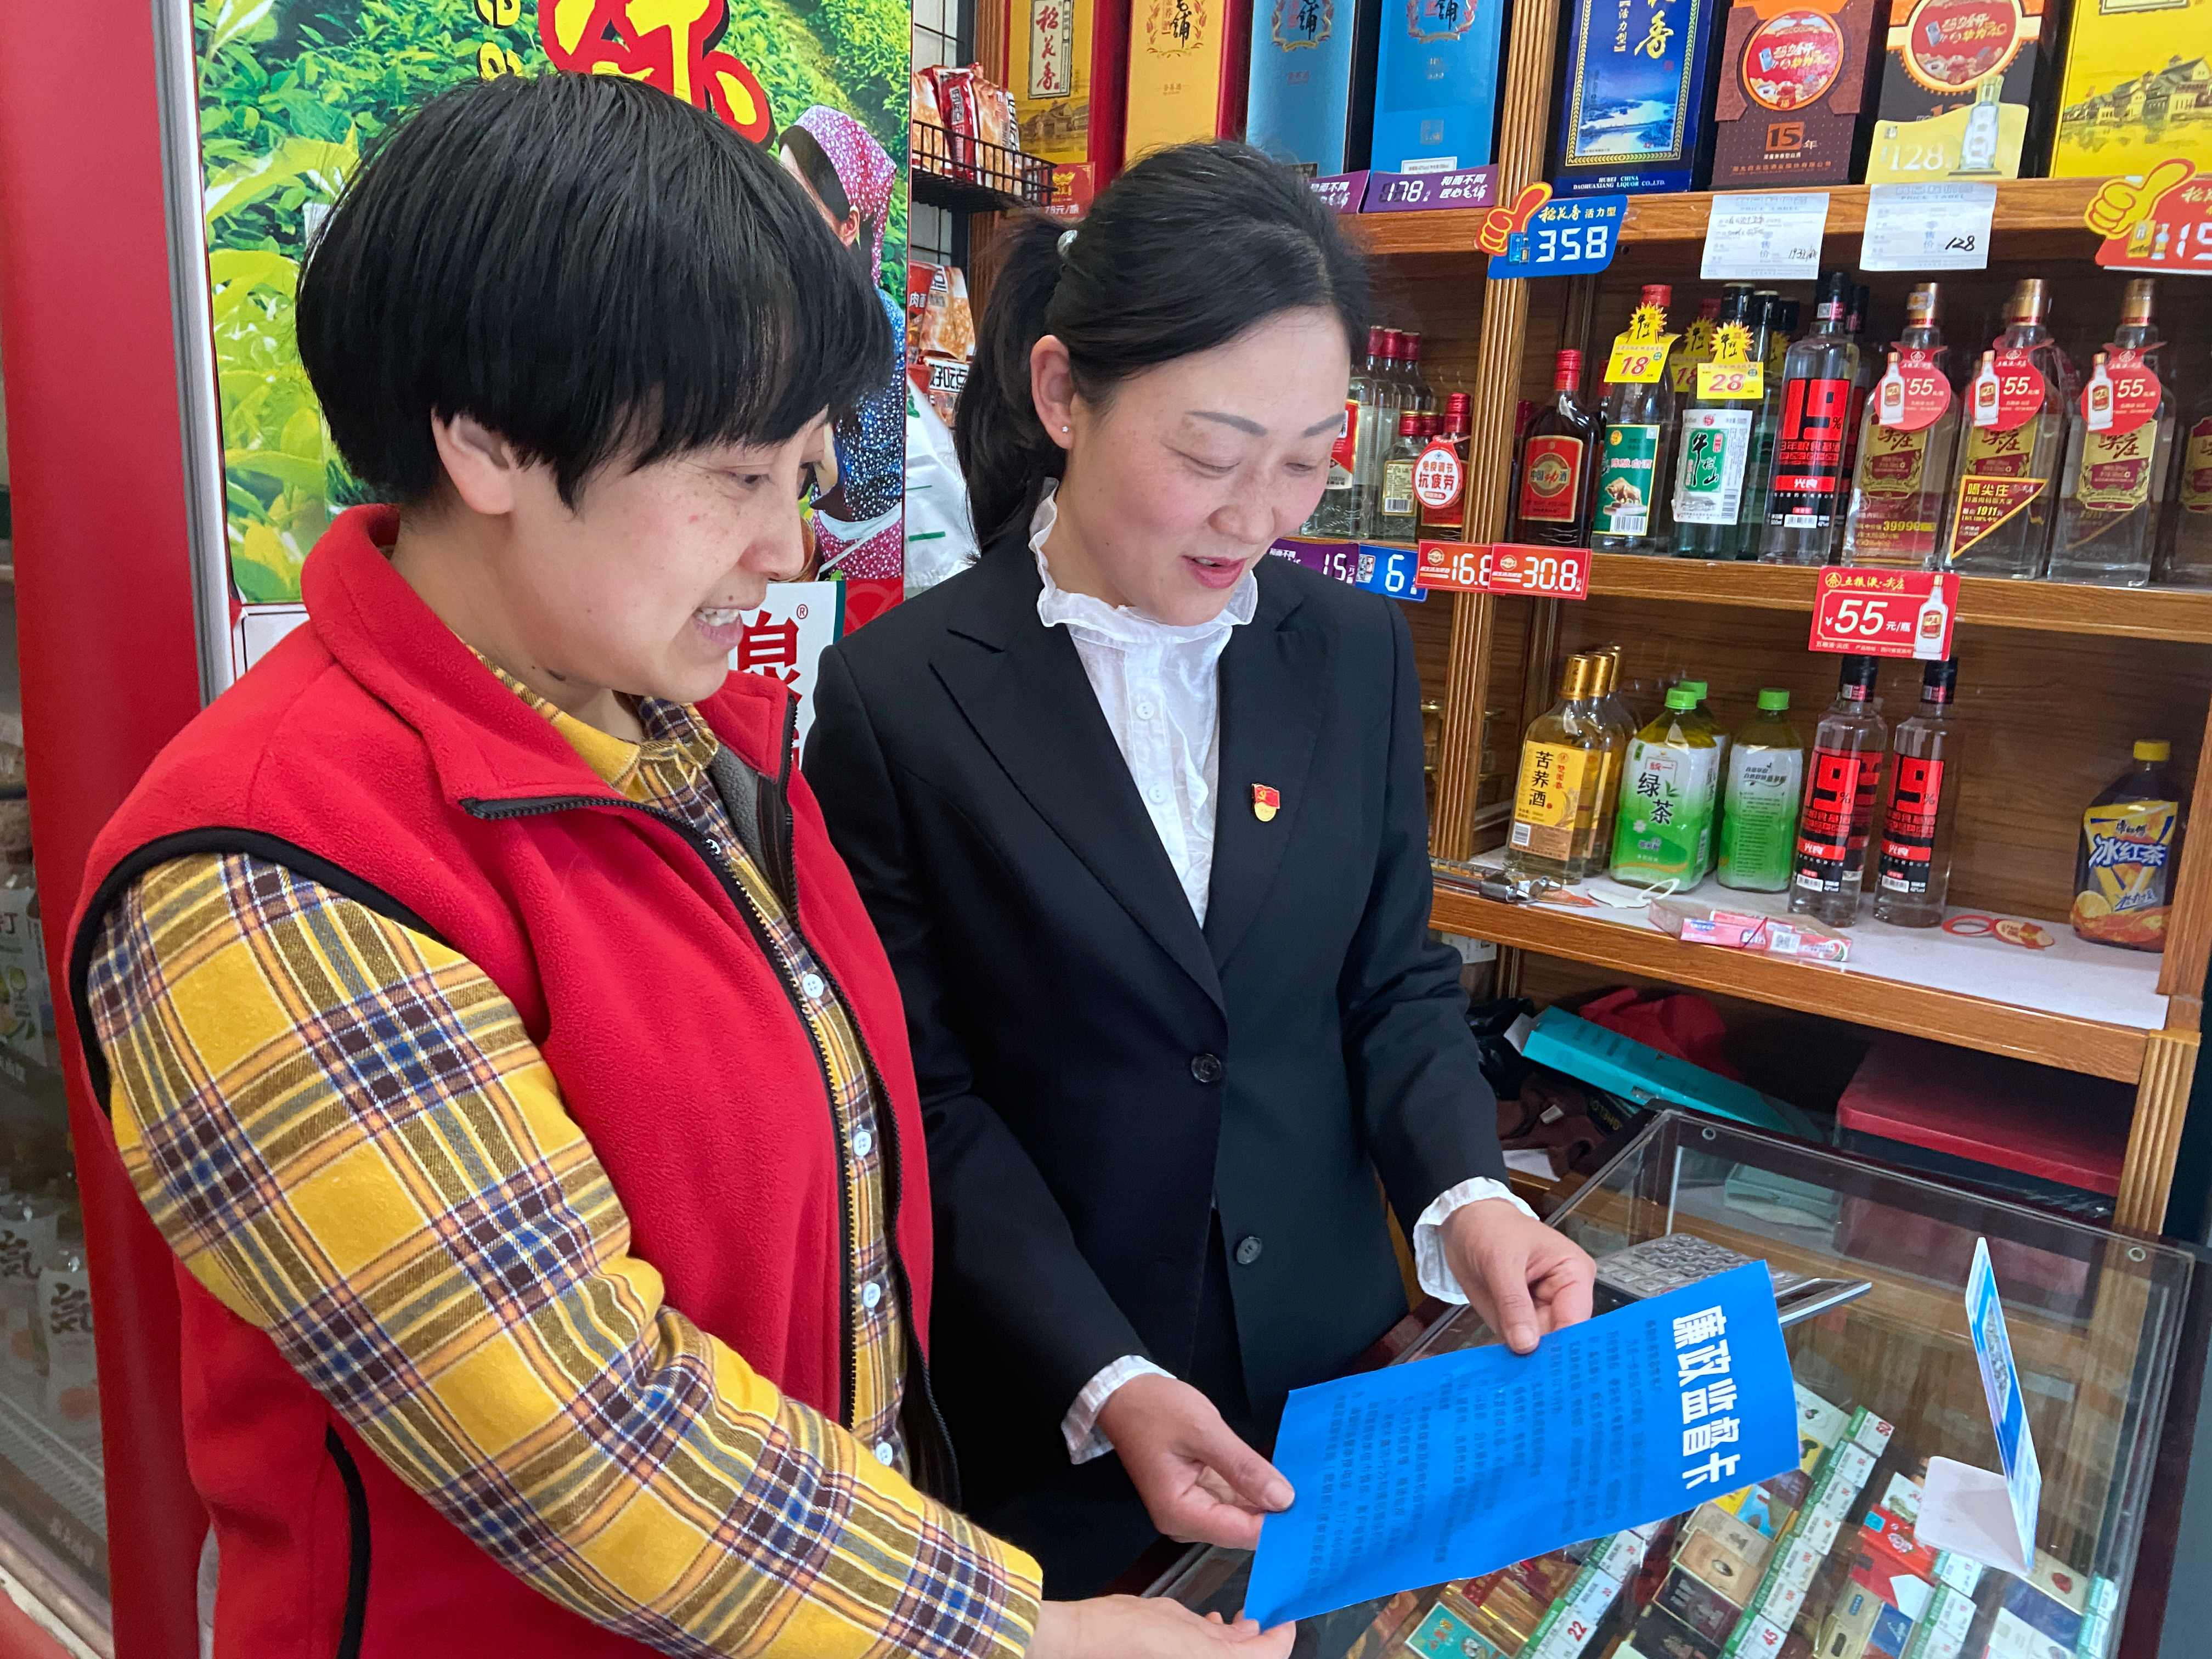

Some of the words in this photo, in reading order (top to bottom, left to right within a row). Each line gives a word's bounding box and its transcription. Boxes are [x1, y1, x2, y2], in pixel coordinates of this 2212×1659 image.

[1441, 173, 1487, 186] 和而不同
[1585, 206, 1617, 219] 活力型
[1536, 225, 1608, 263] 358
[1945, 235, 1976, 251] 128
[1621, 357, 1650, 375] 18
[1709, 374, 1745, 393] 28
[1418, 472, 1454, 491] 抗疲劳
[1967, 483, 2010, 496] 喝尖庄
[1323, 552, 1347, 582] 15
[1385, 554, 1405, 592] 6
[1523, 556, 1578, 591] 30.8
[1650, 762, 1674, 771] 统一
[1529, 751, 1554, 808] 苦荞酒
[1637, 772, 1674, 825] 绿茶
[2089, 833, 2167, 868] 冰红茶
[1672, 1305, 1741, 1490] 廉政监督卡
[1567, 1620, 1588, 1641] 22
[1762, 1629, 1779, 1646] 45
